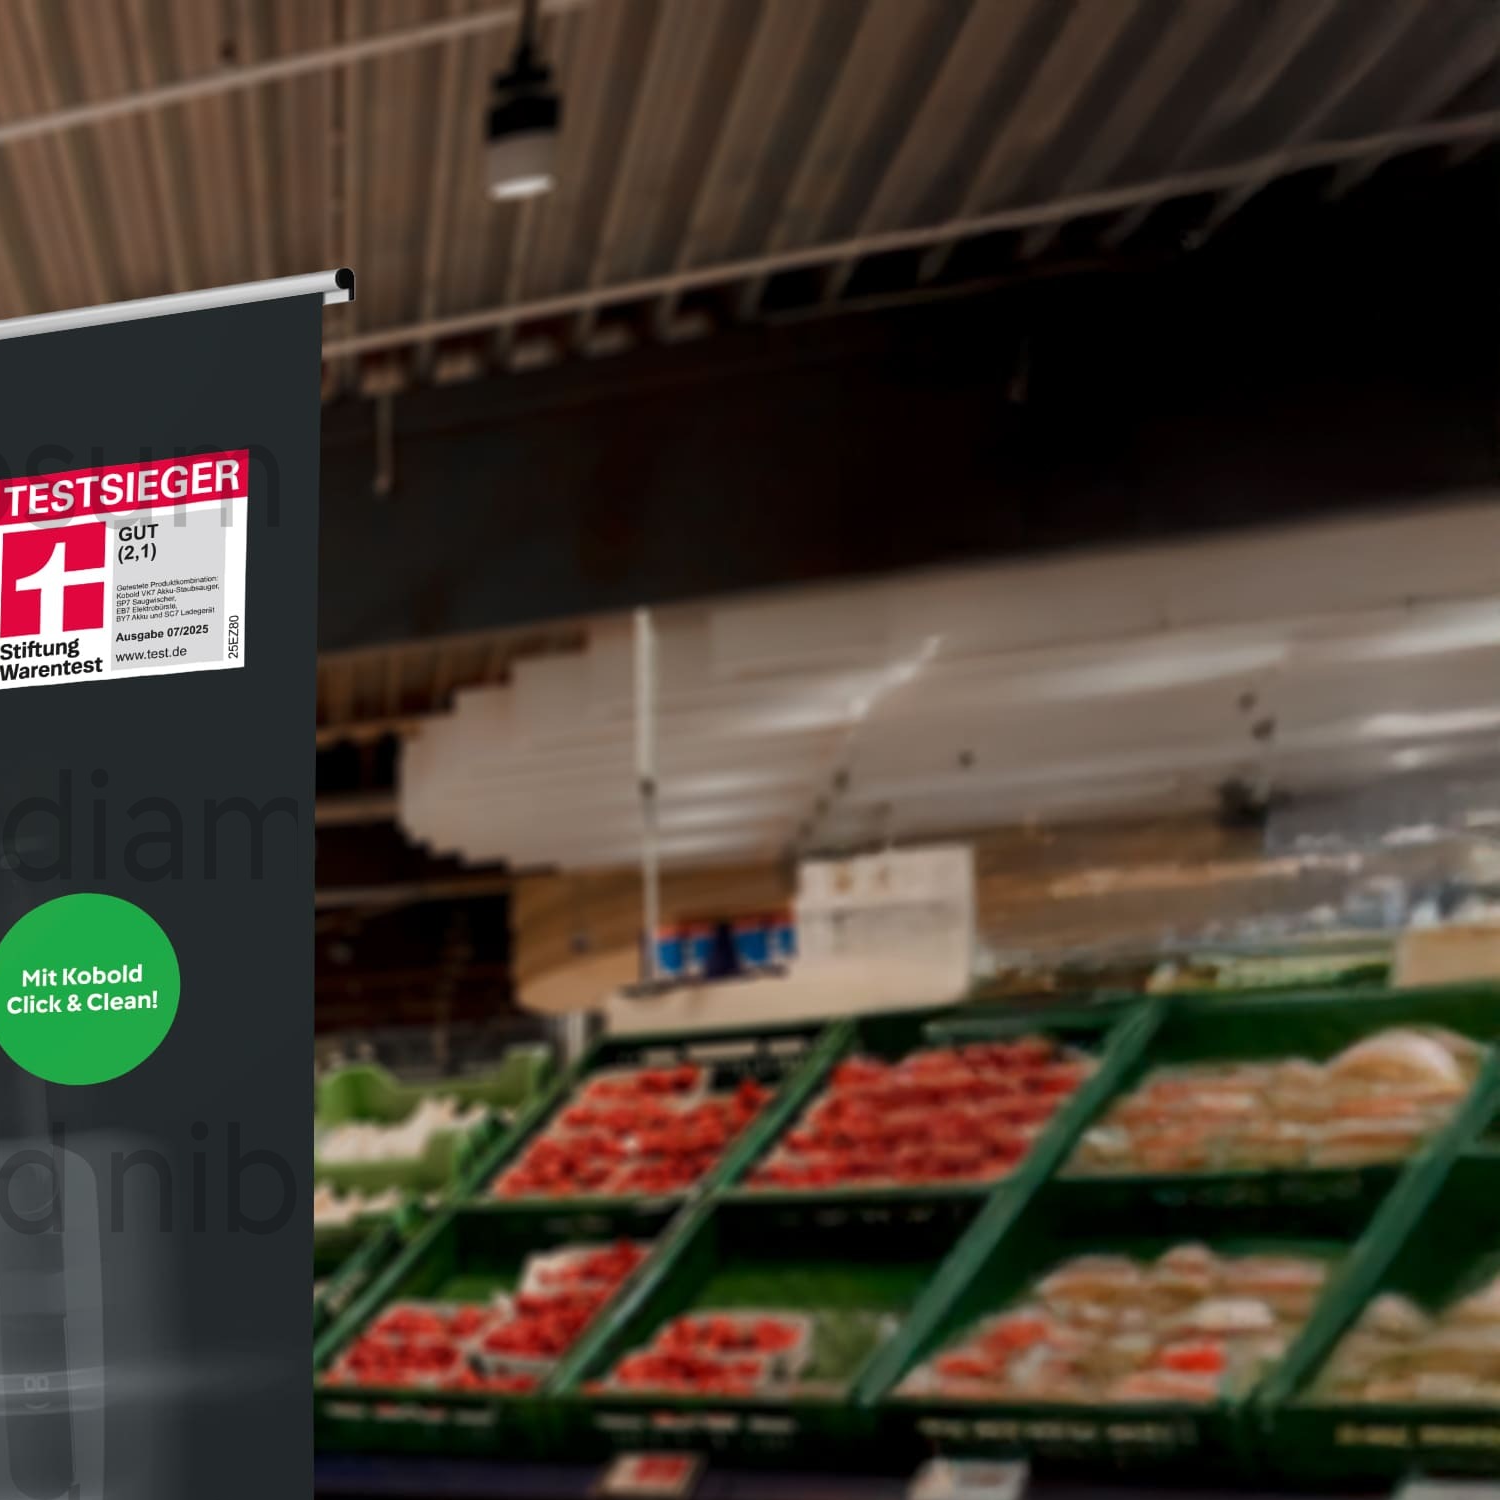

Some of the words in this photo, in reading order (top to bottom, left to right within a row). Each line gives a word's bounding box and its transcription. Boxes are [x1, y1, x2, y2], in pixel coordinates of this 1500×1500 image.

[4, 459, 239, 517] TESTSIEGER
[119, 524, 159, 542] GUT
[118, 543, 156, 564] (2,1)
[116, 629, 164, 643] Ausgabe
[167, 625, 209, 637] 07/2025
[228, 615, 239, 659] 25EZ80
[0, 638, 80, 661] Stiftung
[116, 647, 187, 663] www.test.de
[0, 657, 103, 681] Warentest
[22, 968, 57, 987] Mit
[63, 964, 142, 985] Kobold
[7, 995, 62, 1014] Click
[67, 994, 81, 1012] &
[87, 991, 158, 1011] Clean!
